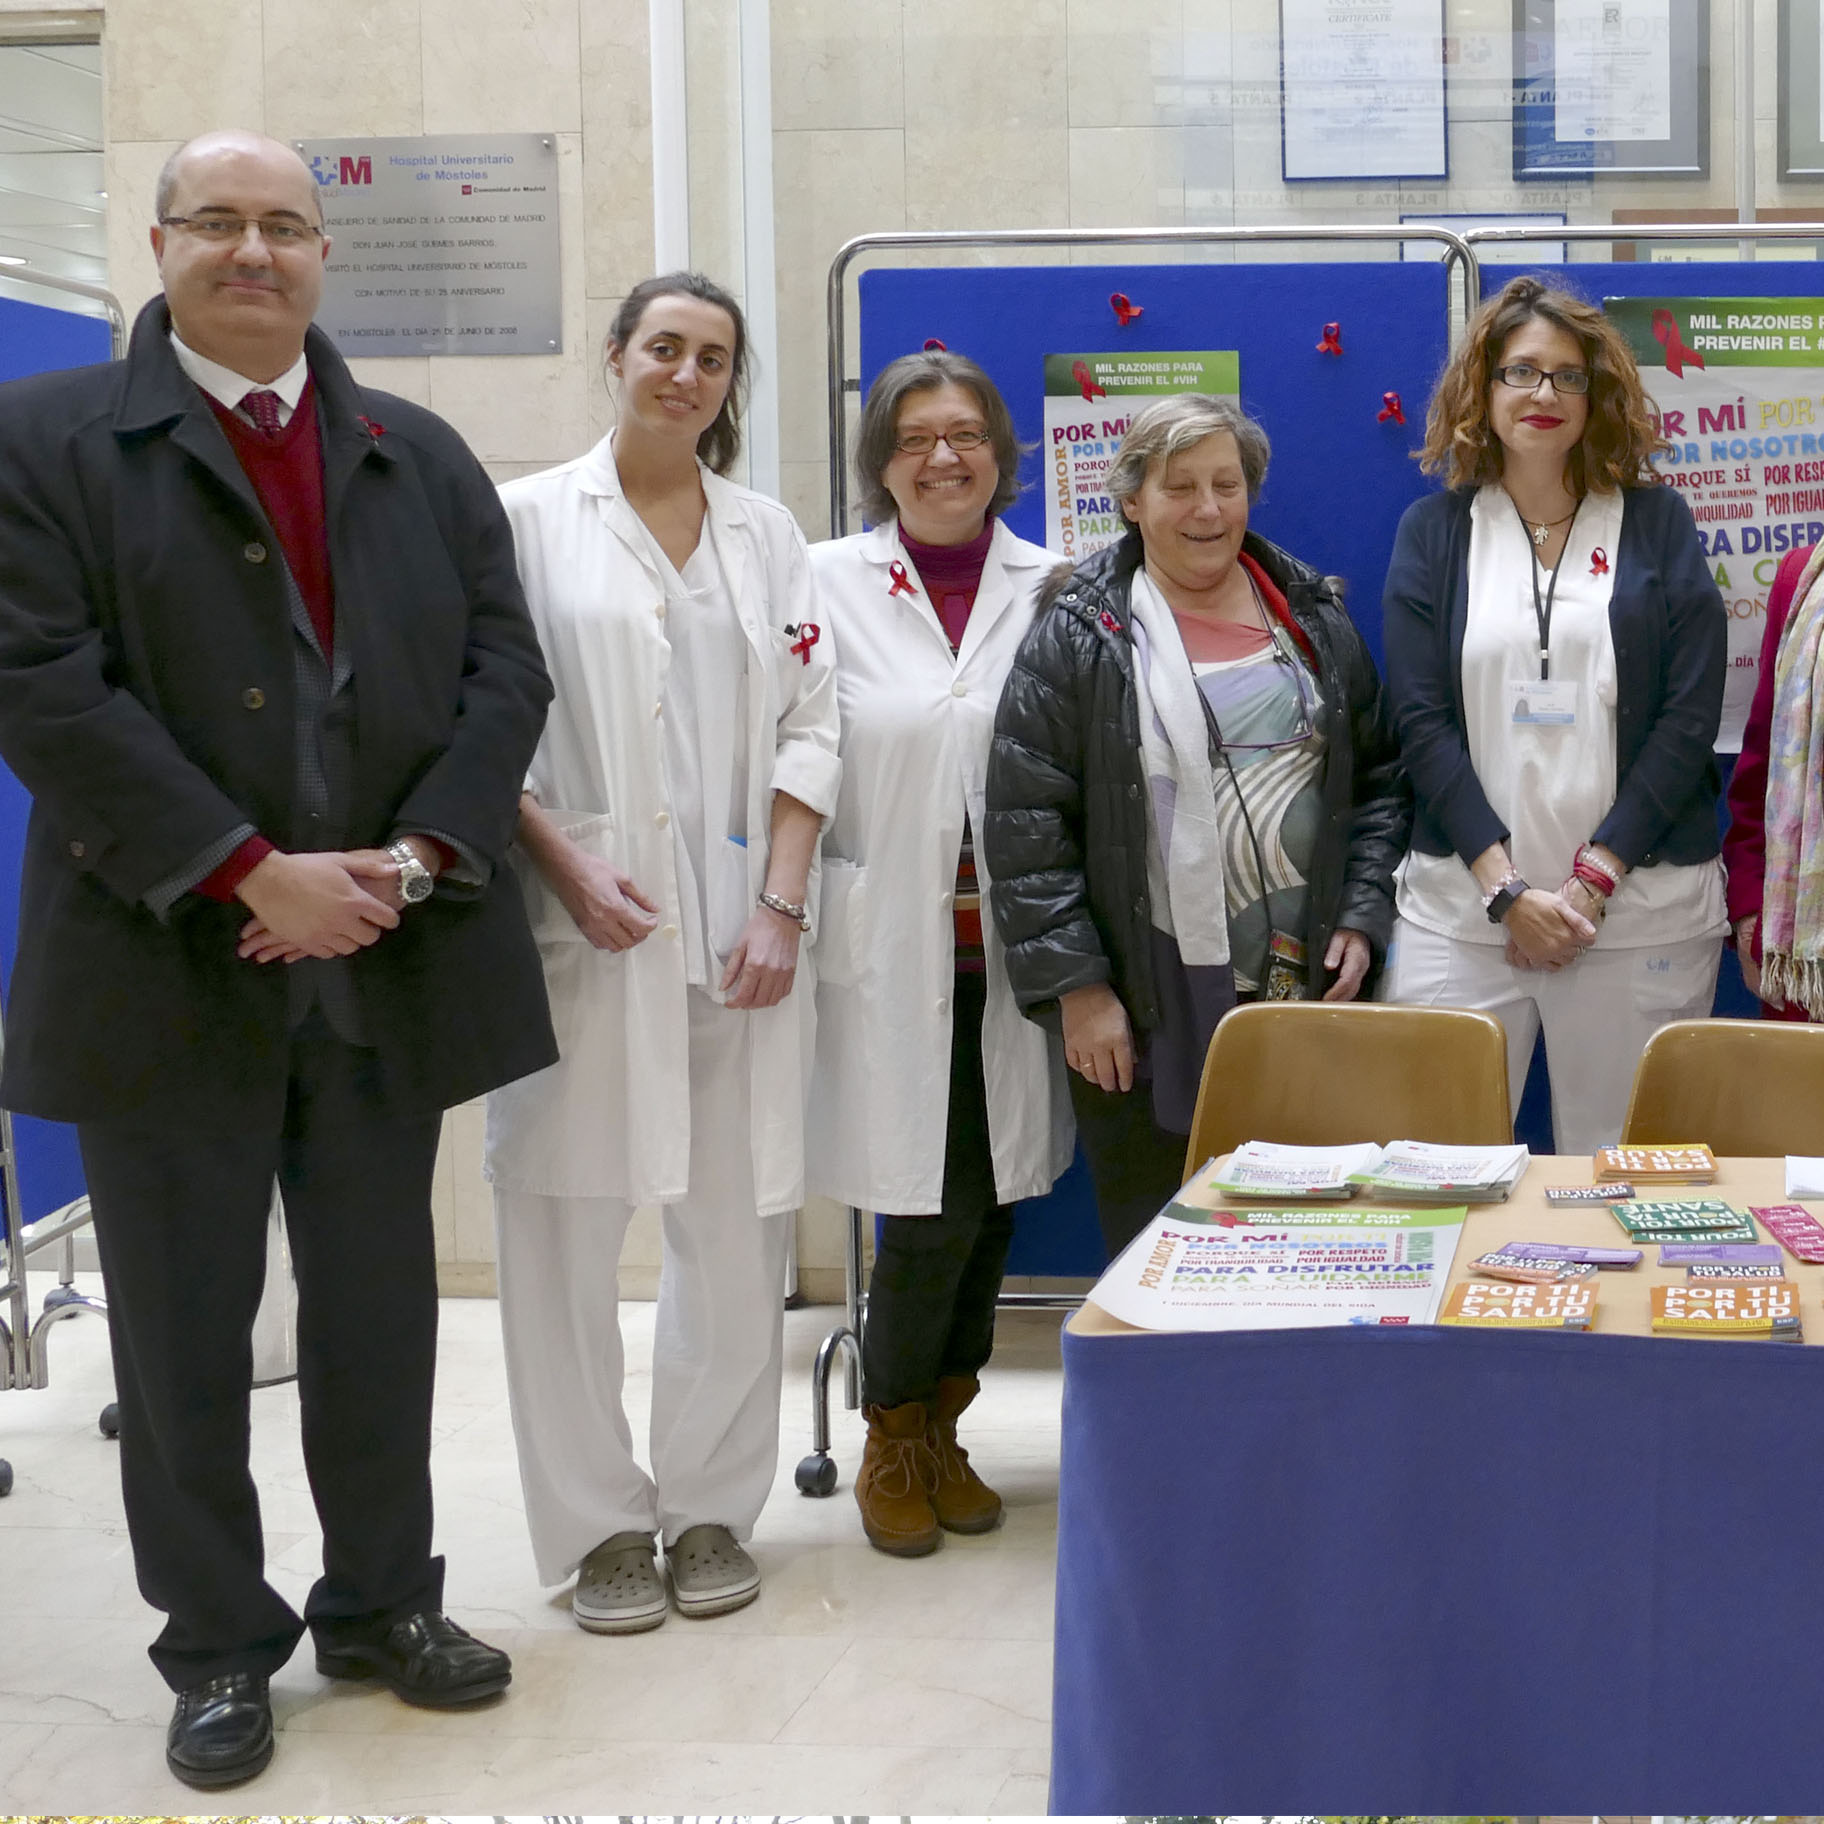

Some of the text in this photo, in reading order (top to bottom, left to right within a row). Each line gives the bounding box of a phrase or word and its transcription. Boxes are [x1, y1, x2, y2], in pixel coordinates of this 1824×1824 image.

[390, 154, 513, 166] Hospital Universitario
[416, 172, 430, 181] de
[1690, 315, 1721, 329] MIL
[1727, 315, 1813, 329] RAZONES
[1694, 336, 1783, 350] PREVENIR
[1789, 337, 1810, 350] EL
[1096, 363, 1203, 373] MIL RAZONES PARA
[1098, 375, 1197, 386] PREVENIR EL #VIH
